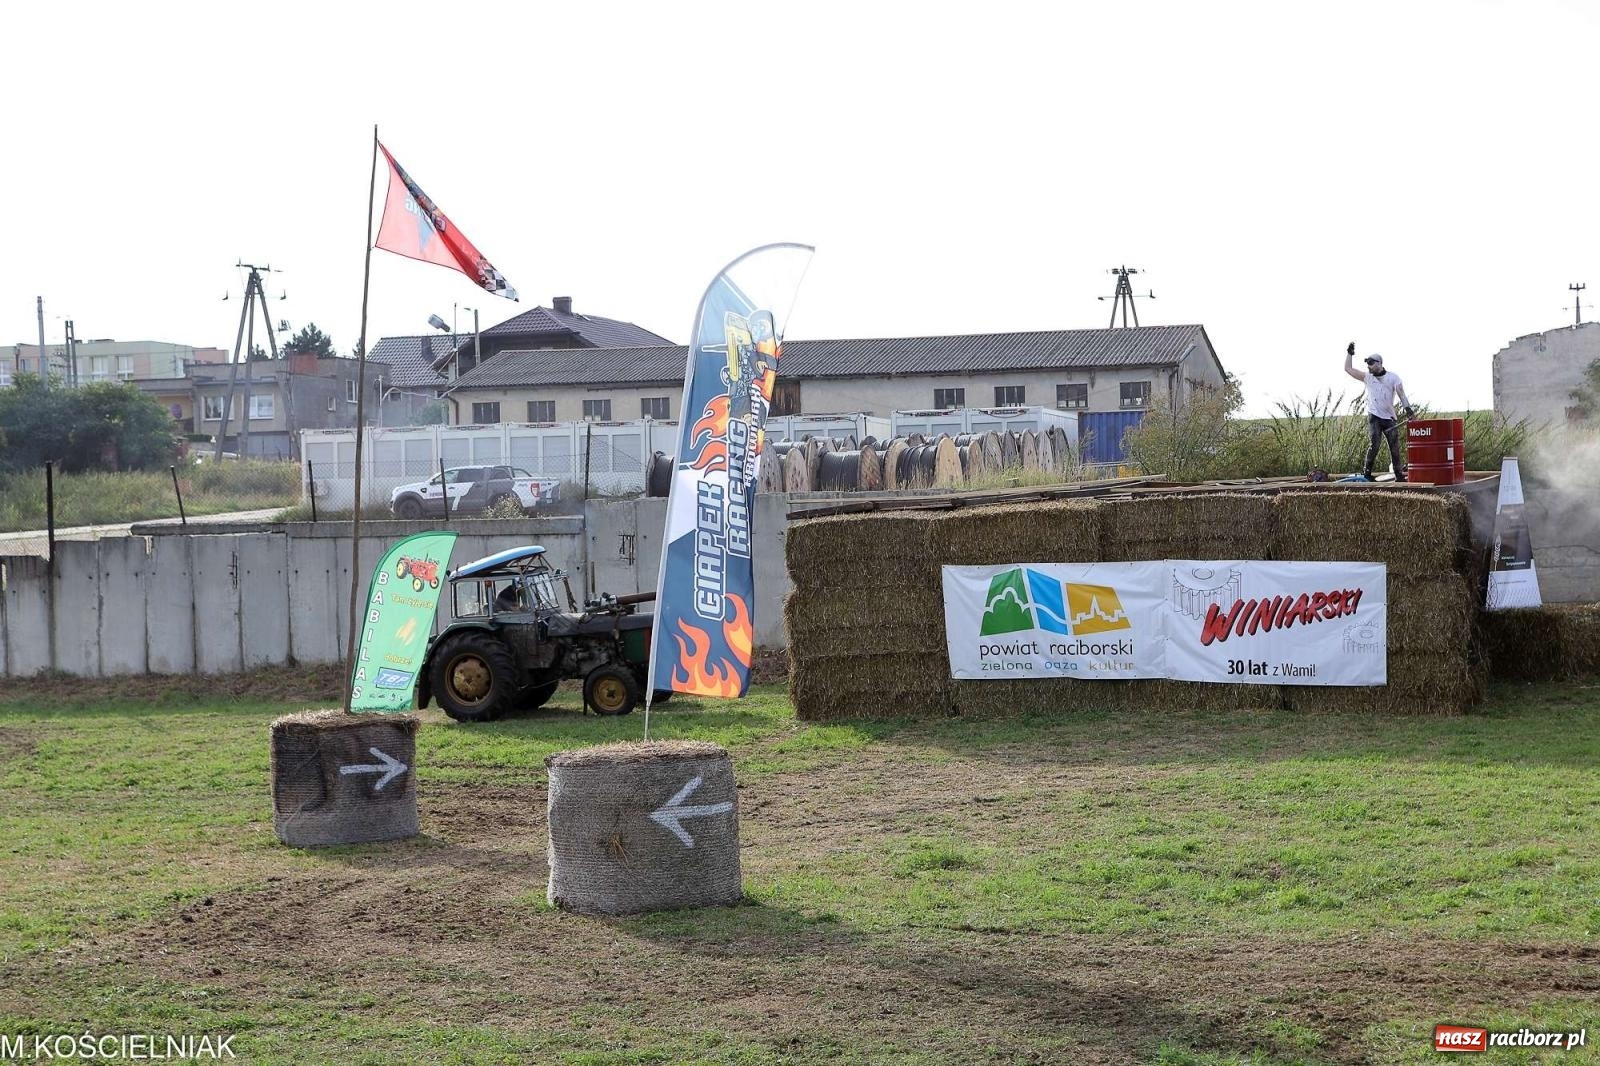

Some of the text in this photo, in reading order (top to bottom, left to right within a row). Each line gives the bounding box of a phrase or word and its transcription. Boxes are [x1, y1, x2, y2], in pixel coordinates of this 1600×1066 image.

[744, 384, 761, 487] KROWIARKI
[1409, 427, 1431, 437] Mobil
[728, 420, 749, 553] RACING
[696, 481, 722, 617] CIAPEK
[352, 571, 389, 699] BABILAS
[1201, 587, 1361, 646] WINIARSKI
[979, 639, 1134, 660] powiat raciborski
[981, 660, 1134, 671] zielona oaza kultur
[1227, 660, 1316, 677] 30 lat z Wami!
